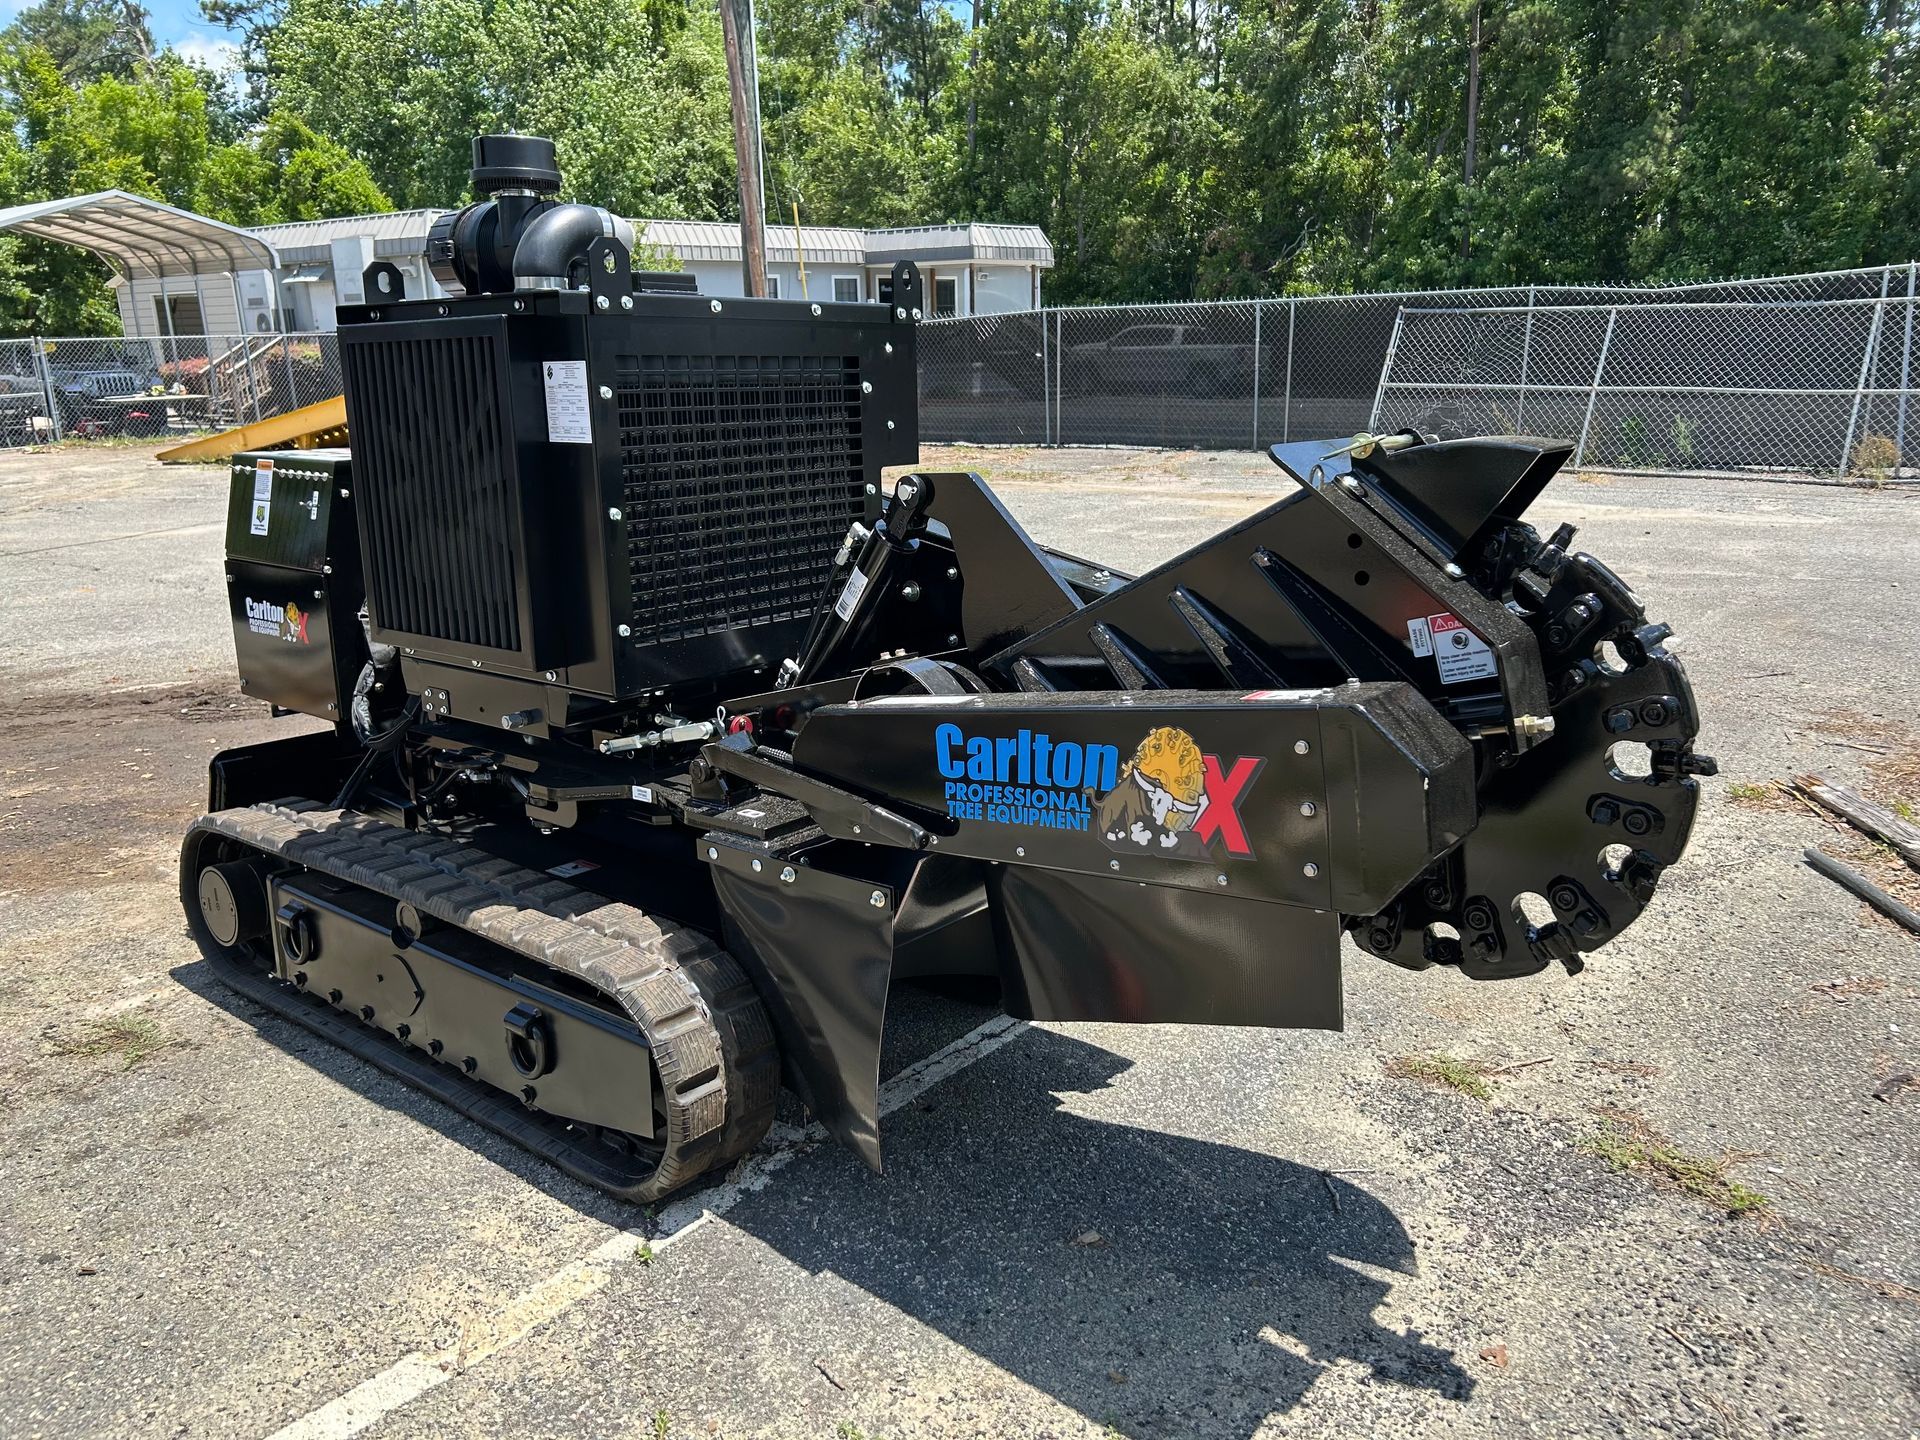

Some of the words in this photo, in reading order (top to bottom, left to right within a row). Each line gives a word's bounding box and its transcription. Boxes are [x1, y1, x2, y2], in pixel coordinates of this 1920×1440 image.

[245, 597, 284, 623] Carlton
[934, 722, 1119, 792] Carlton
[944, 781, 1091, 814] PROFESSIONAL
[1190, 754, 1261, 855] X
[946, 800, 983, 822] TREE
[986, 804, 1091, 832] EQUIPMENT
